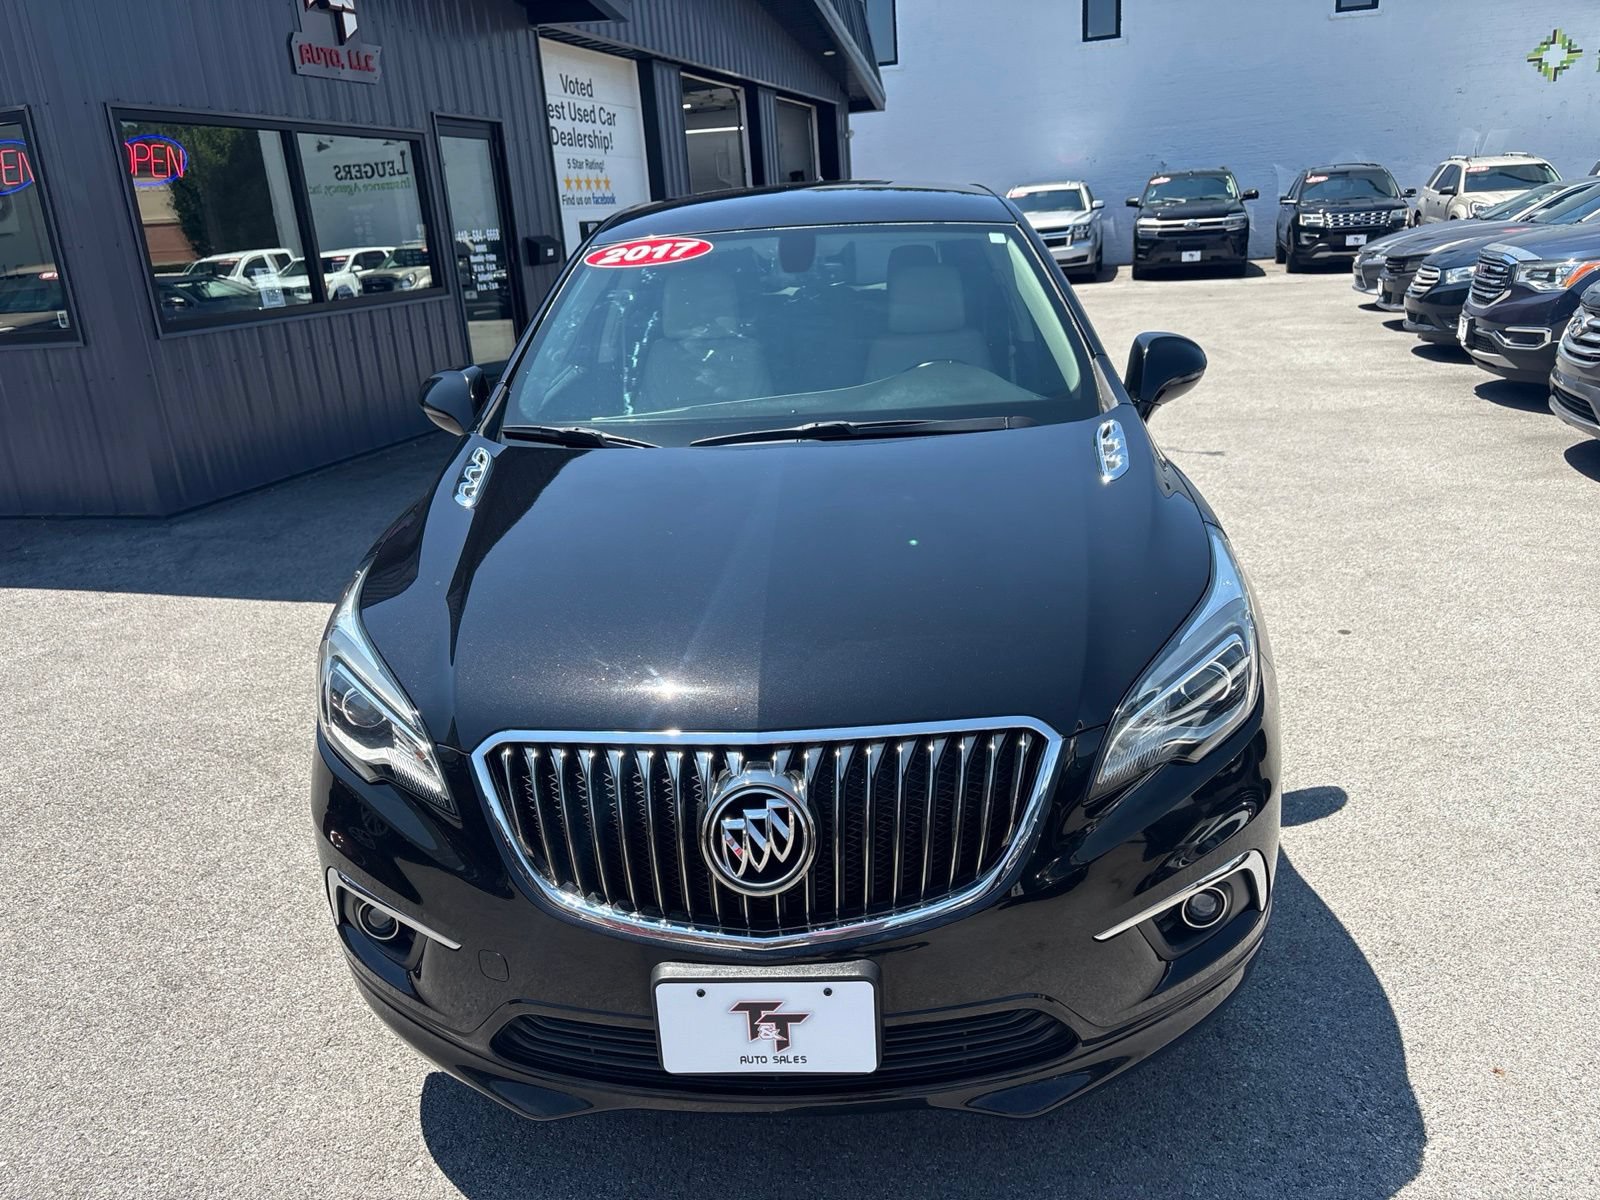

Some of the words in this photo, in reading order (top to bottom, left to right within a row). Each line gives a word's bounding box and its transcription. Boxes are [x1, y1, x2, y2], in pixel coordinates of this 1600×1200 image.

[347, 49, 376, 73] LLC
[559, 73, 594, 98] Voted
[547, 101, 566, 121] est
[568, 101, 597, 124] Used
[599, 104, 617, 127] Car
[550, 126, 614, 155] Dealership!
[0, 149, 36, 185] EN
[567, 158, 571, 170] 5
[572, 158, 584, 170] Star
[562, 194, 575, 206] Find
[576, 196, 583, 206] us
[584, 196, 591, 206] on
[592, 192, 617, 205] facebook
[596, 241, 701, 265] 2017
[728, 999, 811, 1053] T&T
[740, 1055, 768, 1064] AUTO
[772, 1055, 808, 1064] SALES
